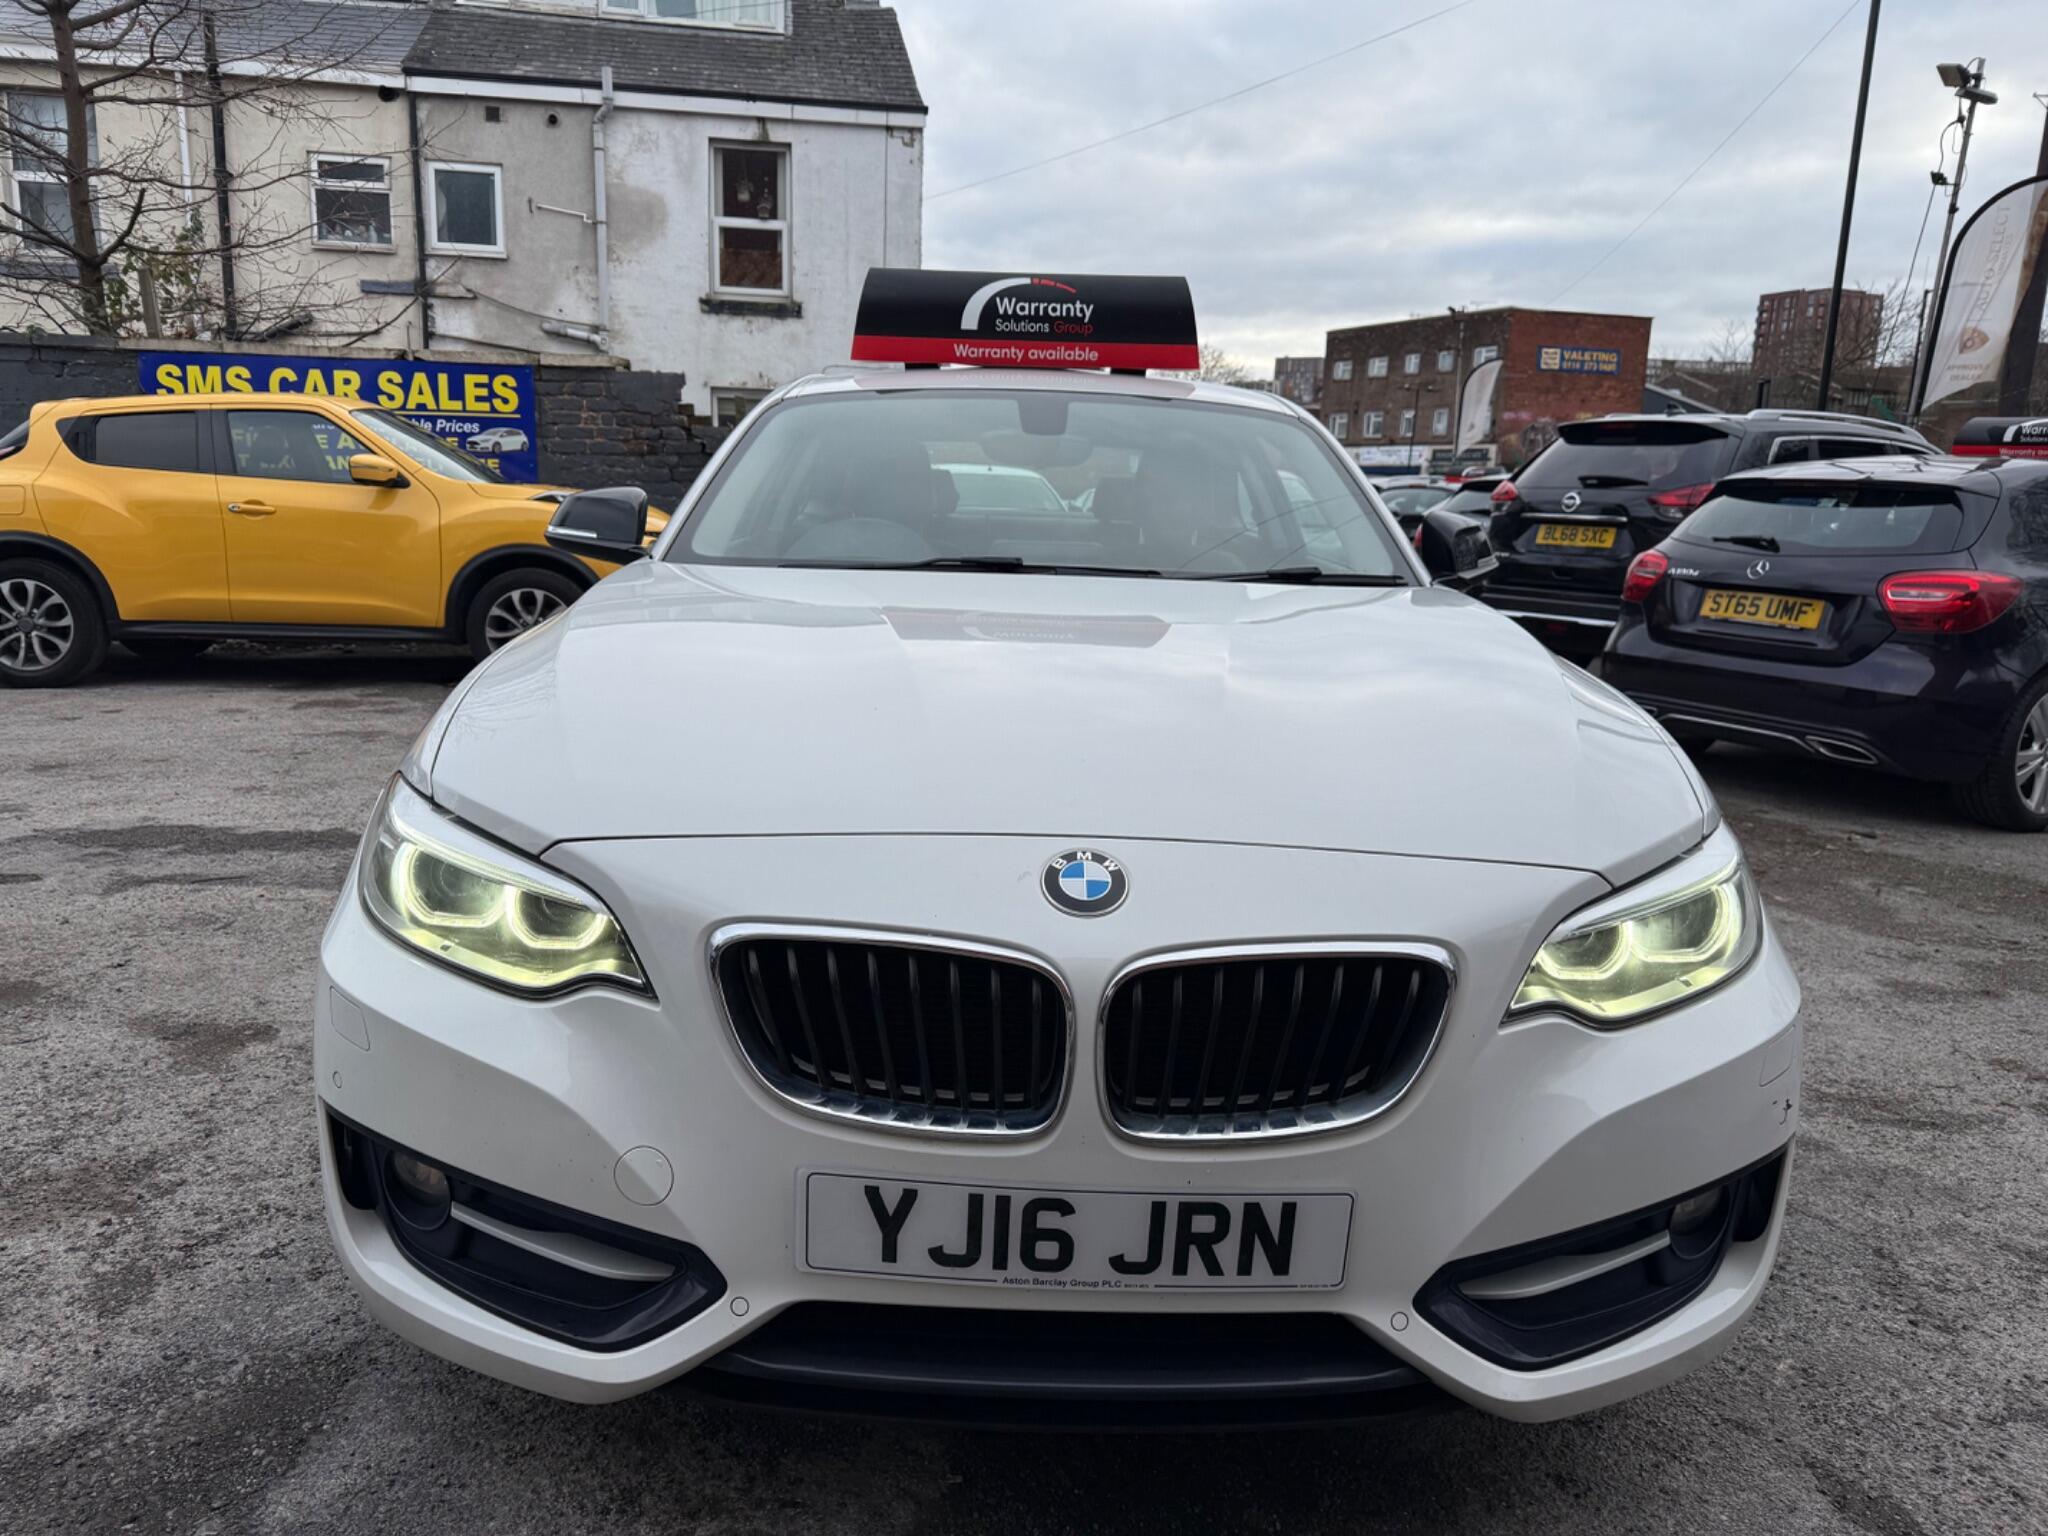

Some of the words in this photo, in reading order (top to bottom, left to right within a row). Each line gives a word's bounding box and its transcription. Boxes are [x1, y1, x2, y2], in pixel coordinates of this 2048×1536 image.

[996, 296, 1094, 324] Warranty
[995, 318, 1049, 333] Solutions
[1054, 321, 1094, 336] Group
[954, 343, 1025, 363] Warranty
[1028, 346, 1099, 362] available
[1563, 350, 1617, 362] VALETING
[156, 363, 254, 394] SMS
[269, 367, 361, 400] CAR
[378, 370, 520, 413] SALES
[436, 418, 480, 434] Prices
[1543, 526, 1577, 541] BL68
[1581, 528, 1610, 544] SXC
[1710, 593, 1761, 616] ST65
[1765, 599, 1813, 622] UMF
[1051, 852, 1119, 871] BMW
[864, 1185, 1076, 1273] YJ16
[1109, 1201, 1297, 1276] JRN
[1002, 1276, 1030, 1285] Aston
[1032, 1278, 1067, 1288] Barclay
[1069, 1279, 1099, 1289] Group
[1102, 1280, 1121, 1288] PLC
